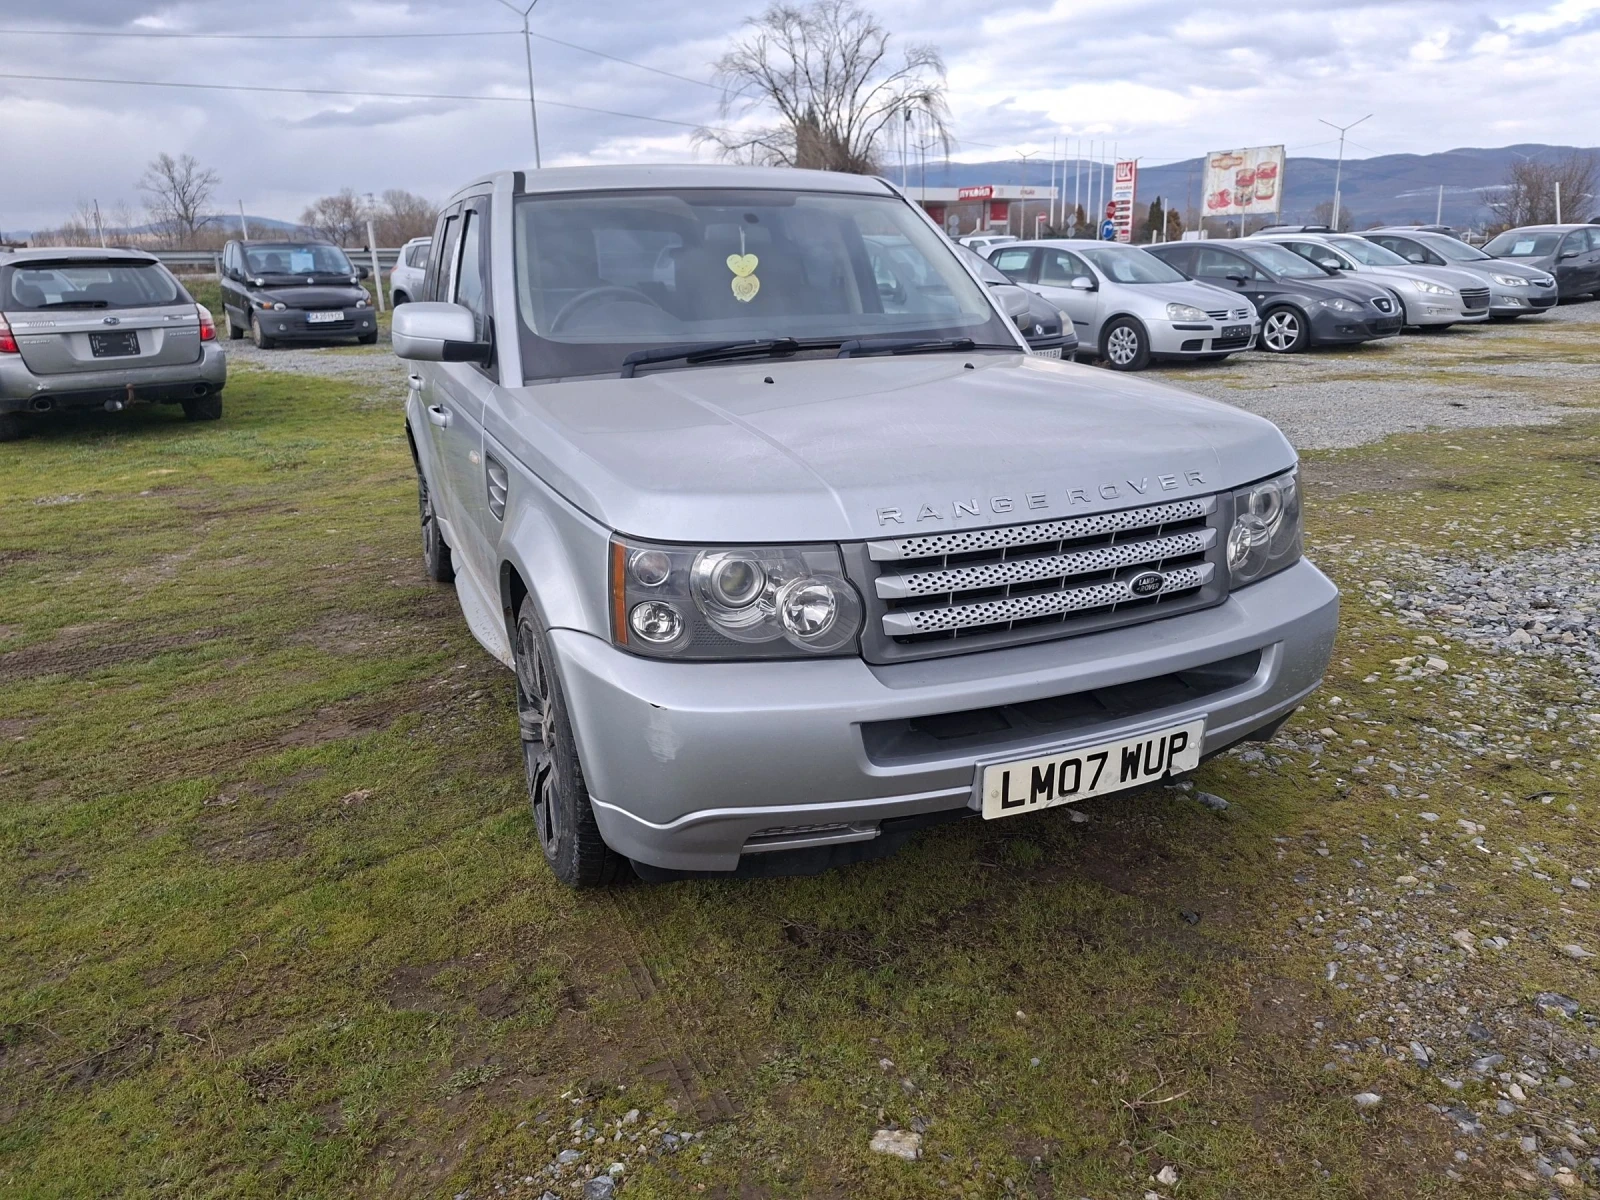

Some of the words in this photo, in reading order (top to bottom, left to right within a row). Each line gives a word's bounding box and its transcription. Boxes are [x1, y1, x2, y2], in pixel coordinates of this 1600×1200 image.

[876, 491, 1049, 526] RANGE
[1066, 468, 1206, 504] ROVER
[1138, 578, 1154, 586] LAND
[1140, 583, 1159, 592] ROVER
[1001, 751, 1109, 810] LM07
[1119, 731, 1188, 783] WUP
